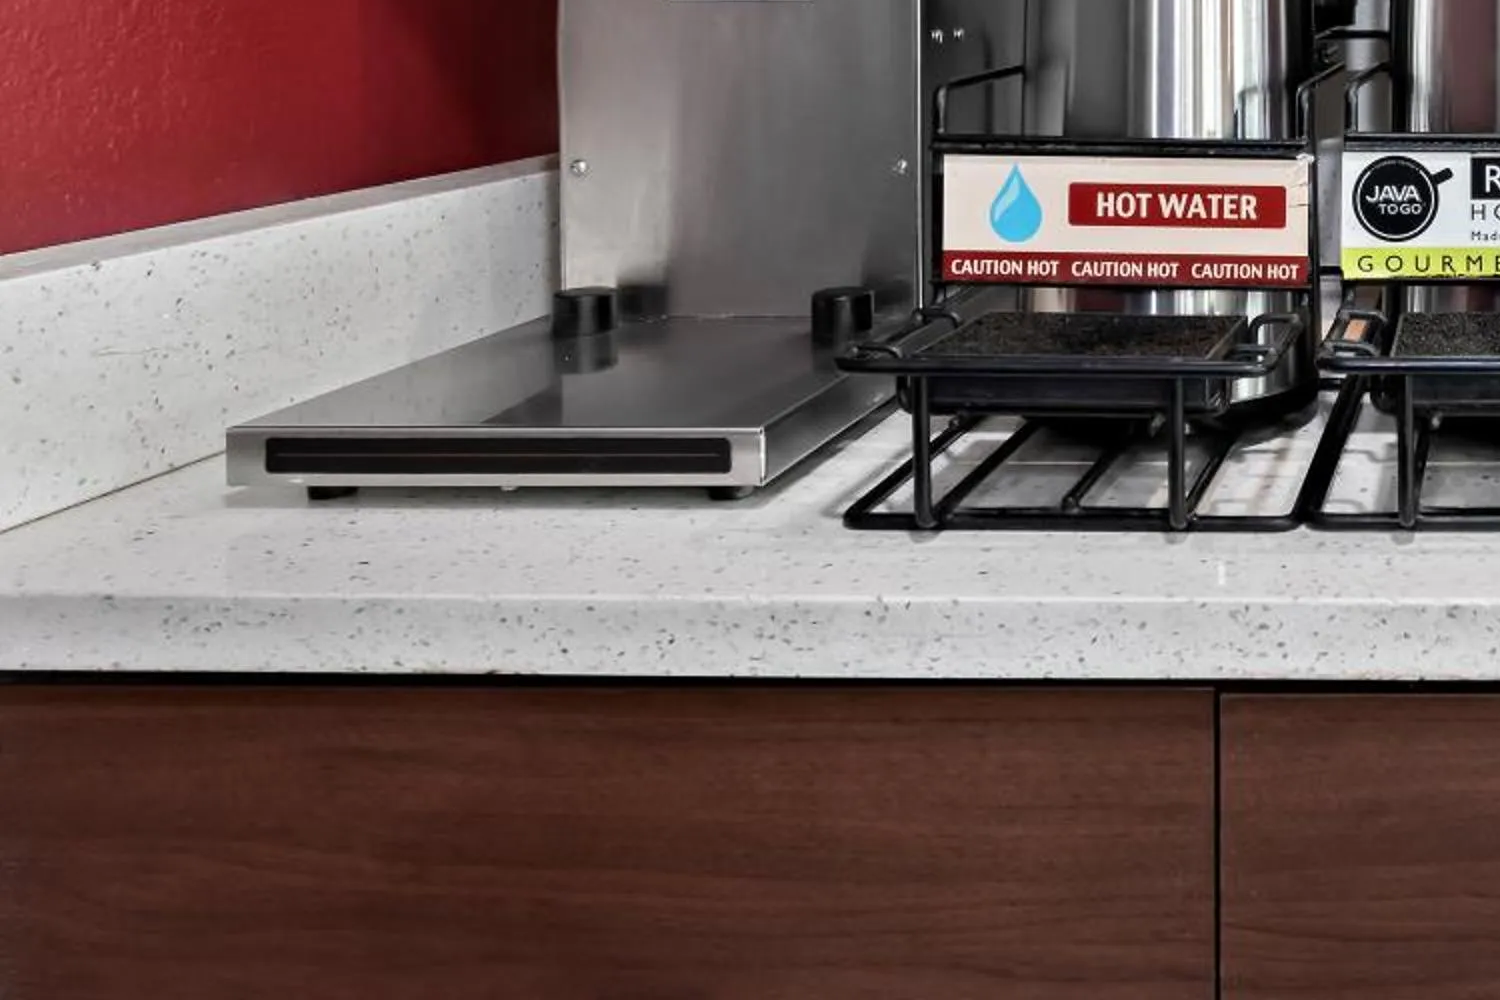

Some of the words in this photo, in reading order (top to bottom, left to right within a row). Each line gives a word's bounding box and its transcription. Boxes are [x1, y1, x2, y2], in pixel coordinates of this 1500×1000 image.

[1366, 184, 1423, 203] JAVA
[1096, 192, 1153, 219] HOT
[1157, 193, 1258, 220] WATER
[951, 259, 1023, 277] CAUTION
[1027, 260, 1060, 277] HOT
[1071, 261, 1144, 278] CAUTION
[1147, 262, 1180, 279] HOT
[1191, 263, 1264, 280] CAUTION
[1266, 264, 1300, 281] HOT
